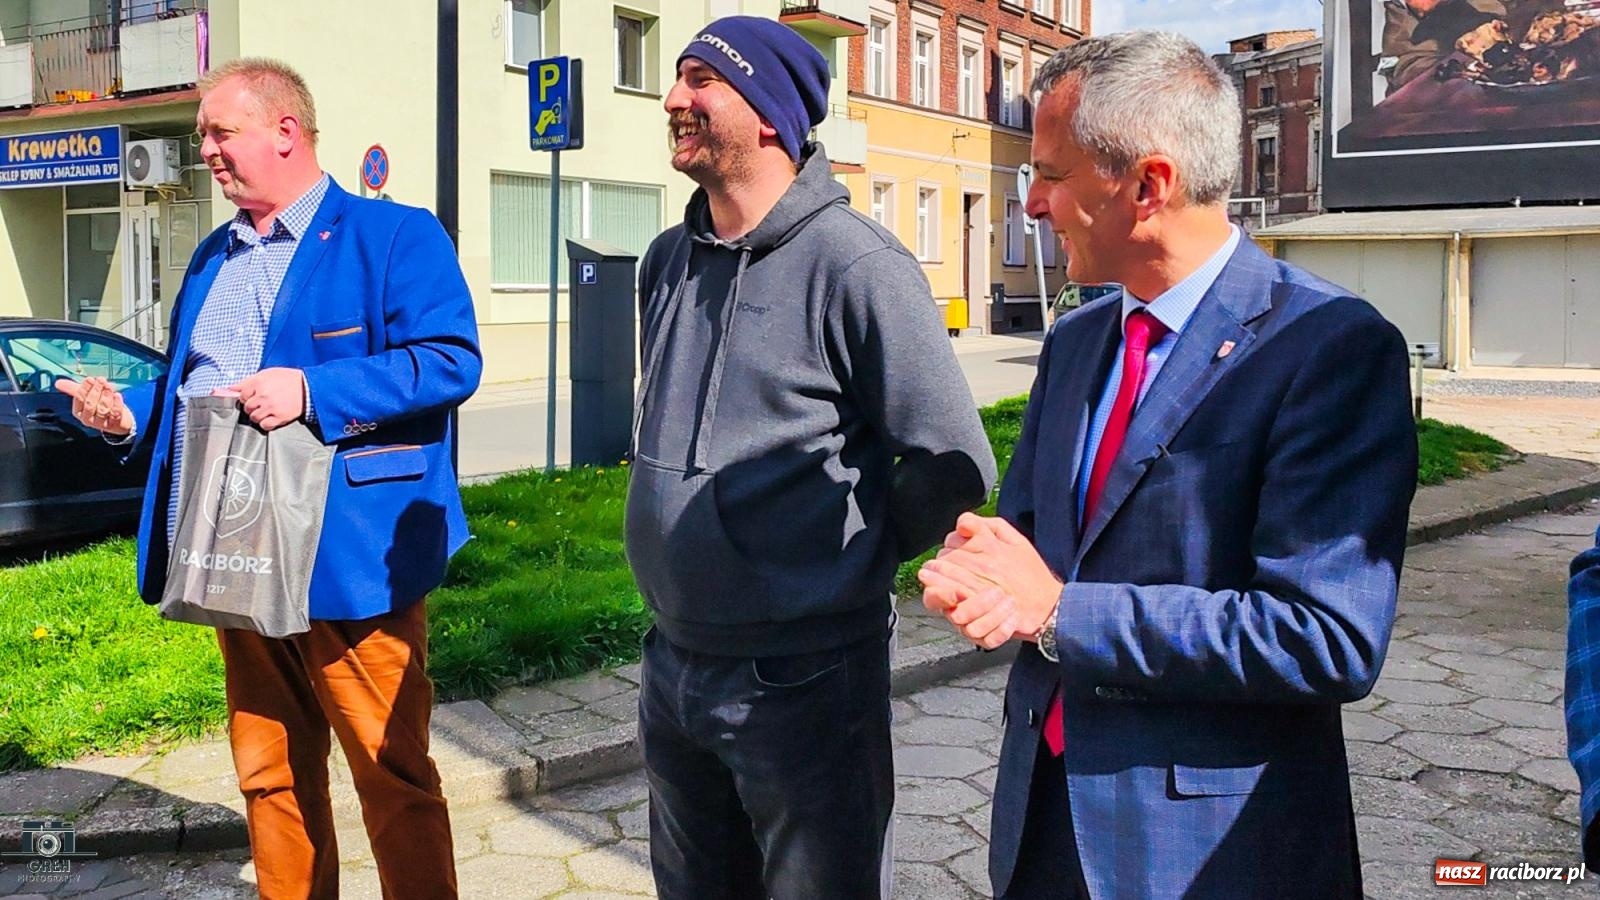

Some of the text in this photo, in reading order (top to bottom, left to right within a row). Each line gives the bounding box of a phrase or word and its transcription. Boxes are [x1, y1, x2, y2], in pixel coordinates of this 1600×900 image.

[539, 63, 560, 102] P
[8, 133, 102, 162] Krewetka
[532, 135, 565, 147] PARKOMAT
[20, 168, 45, 181] RYBNY
[46, 167, 52, 179] &
[53, 163, 101, 178] SMAŻALNIA
[102, 163, 118, 175] RYB
[582, 264, 594, 282] P
[179, 548, 273, 574] RACIBÓRZ
[206, 584, 226, 594] 1217
